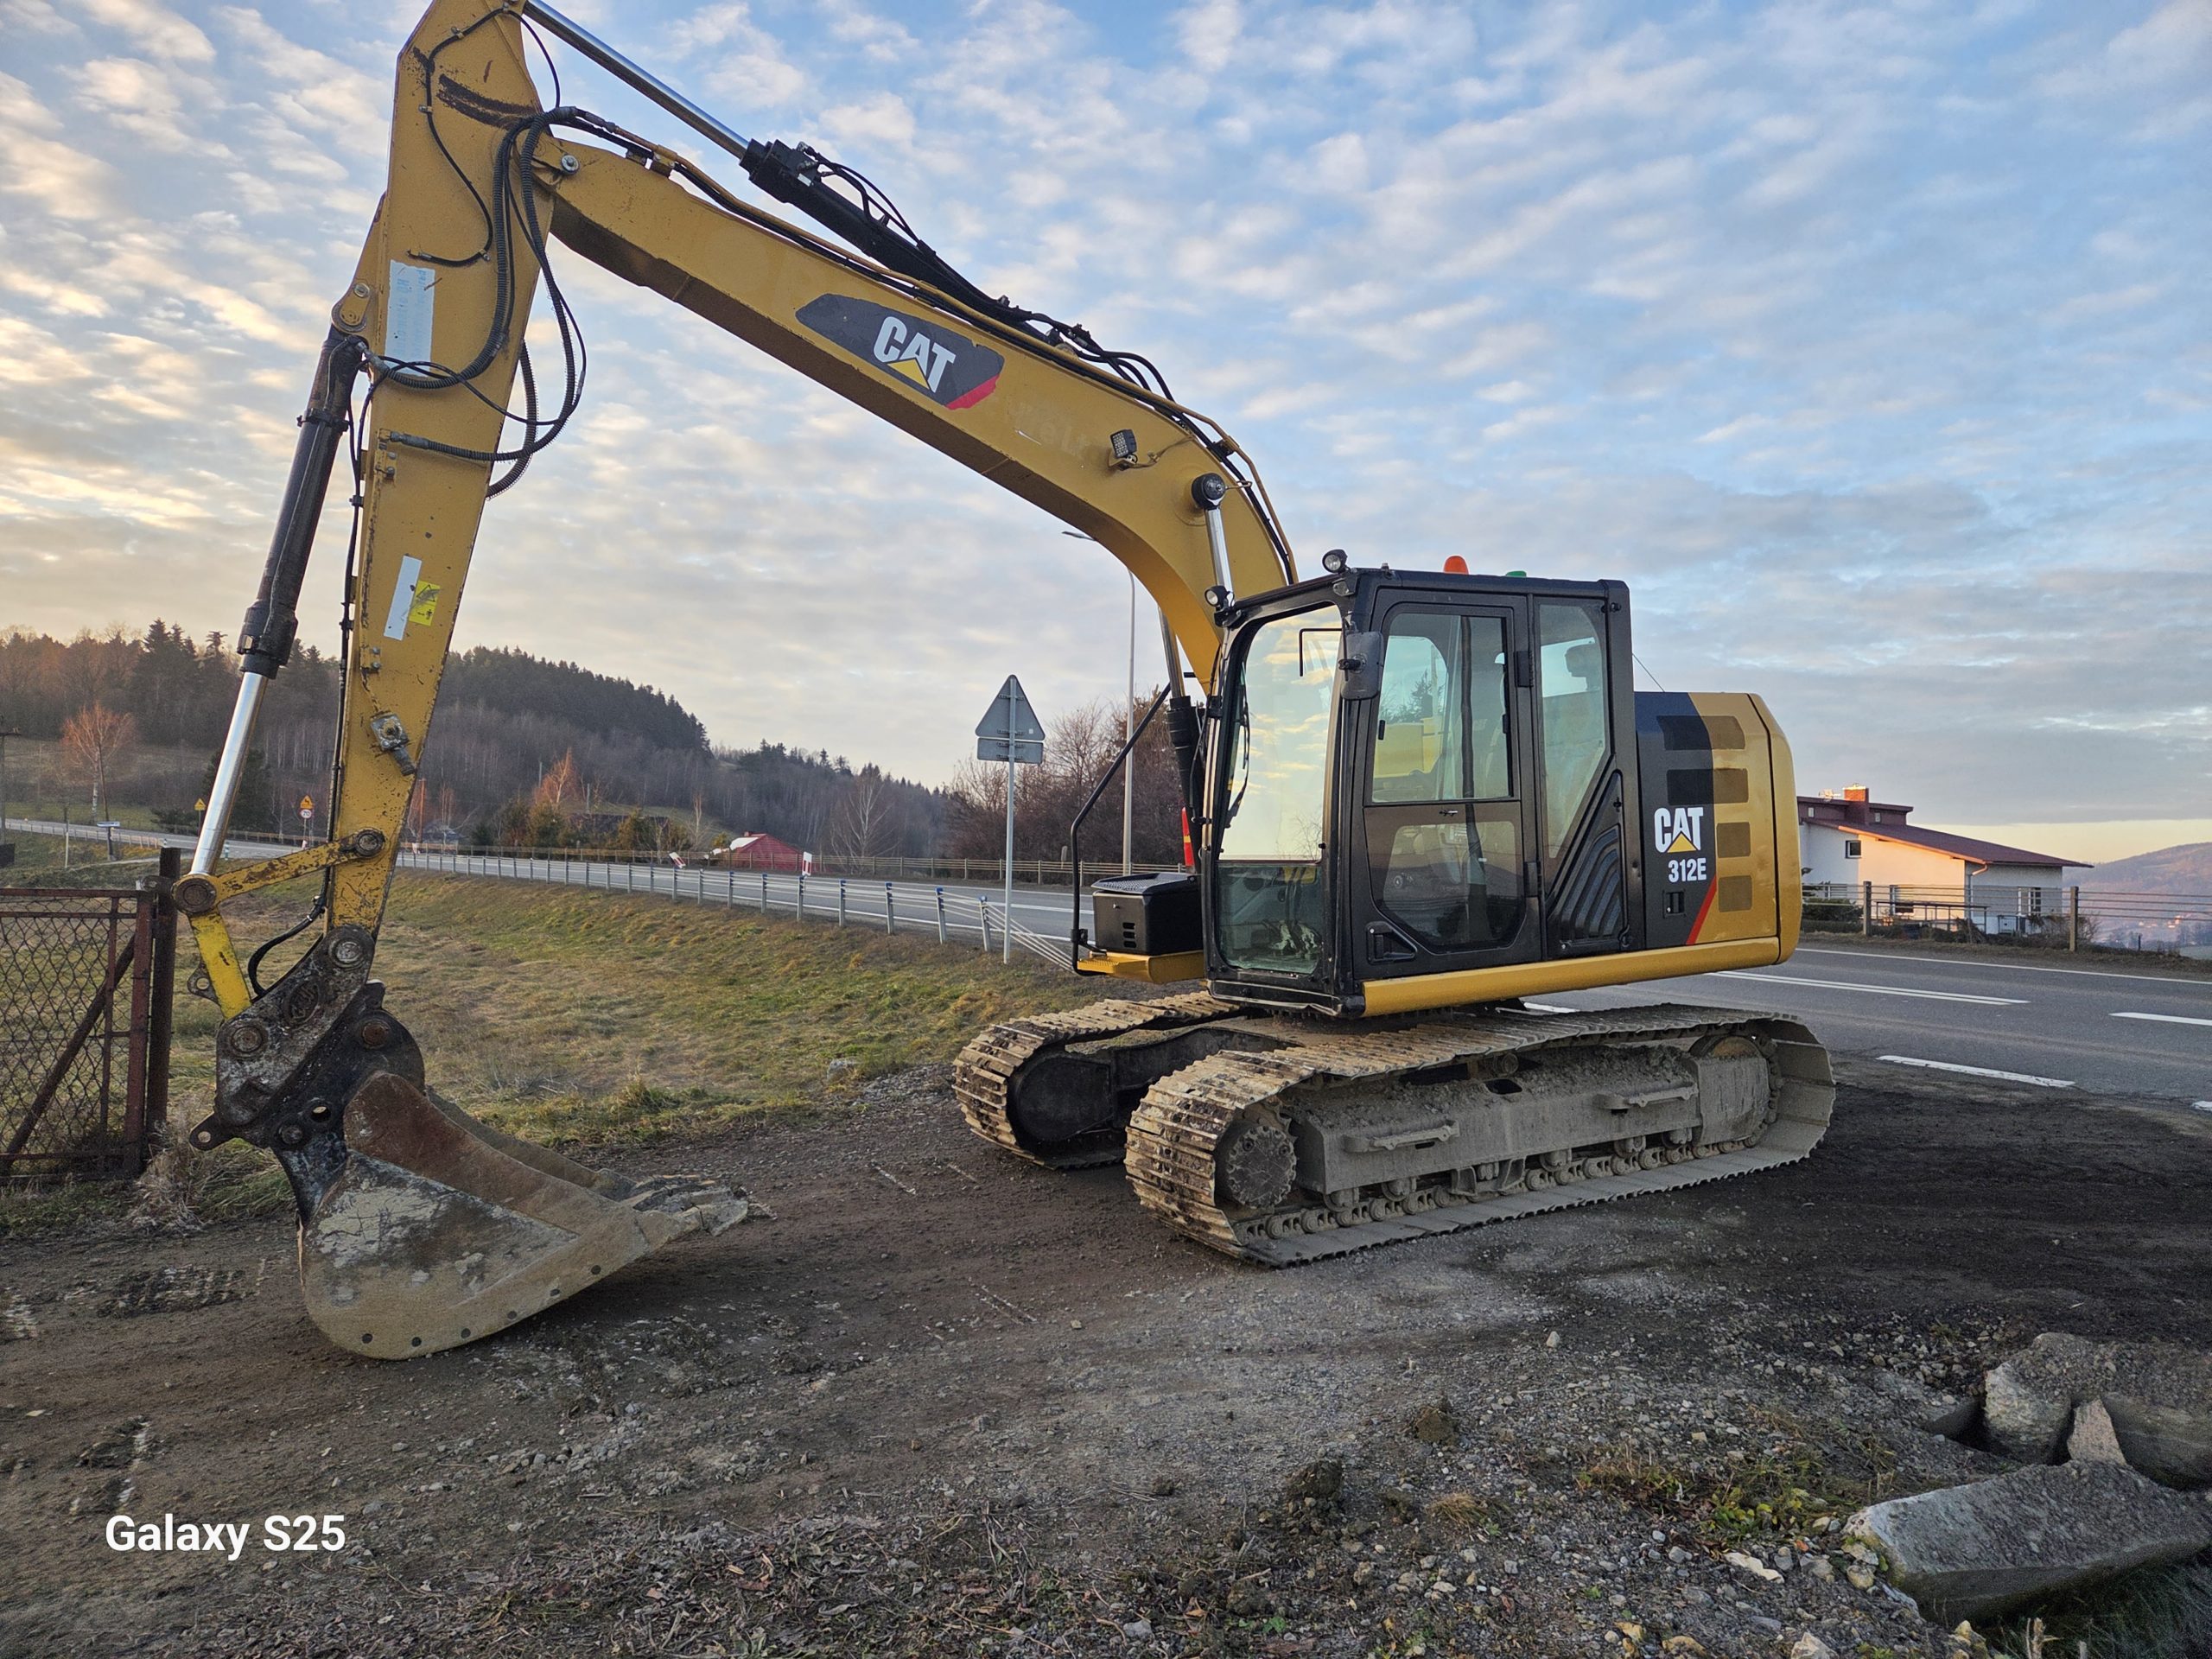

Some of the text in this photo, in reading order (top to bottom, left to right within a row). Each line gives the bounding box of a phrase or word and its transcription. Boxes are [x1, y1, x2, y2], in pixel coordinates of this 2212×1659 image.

[873, 315, 957, 393] CAT
[1654, 807, 1704, 853] CAT
[1668, 857, 1707, 883] 312E
